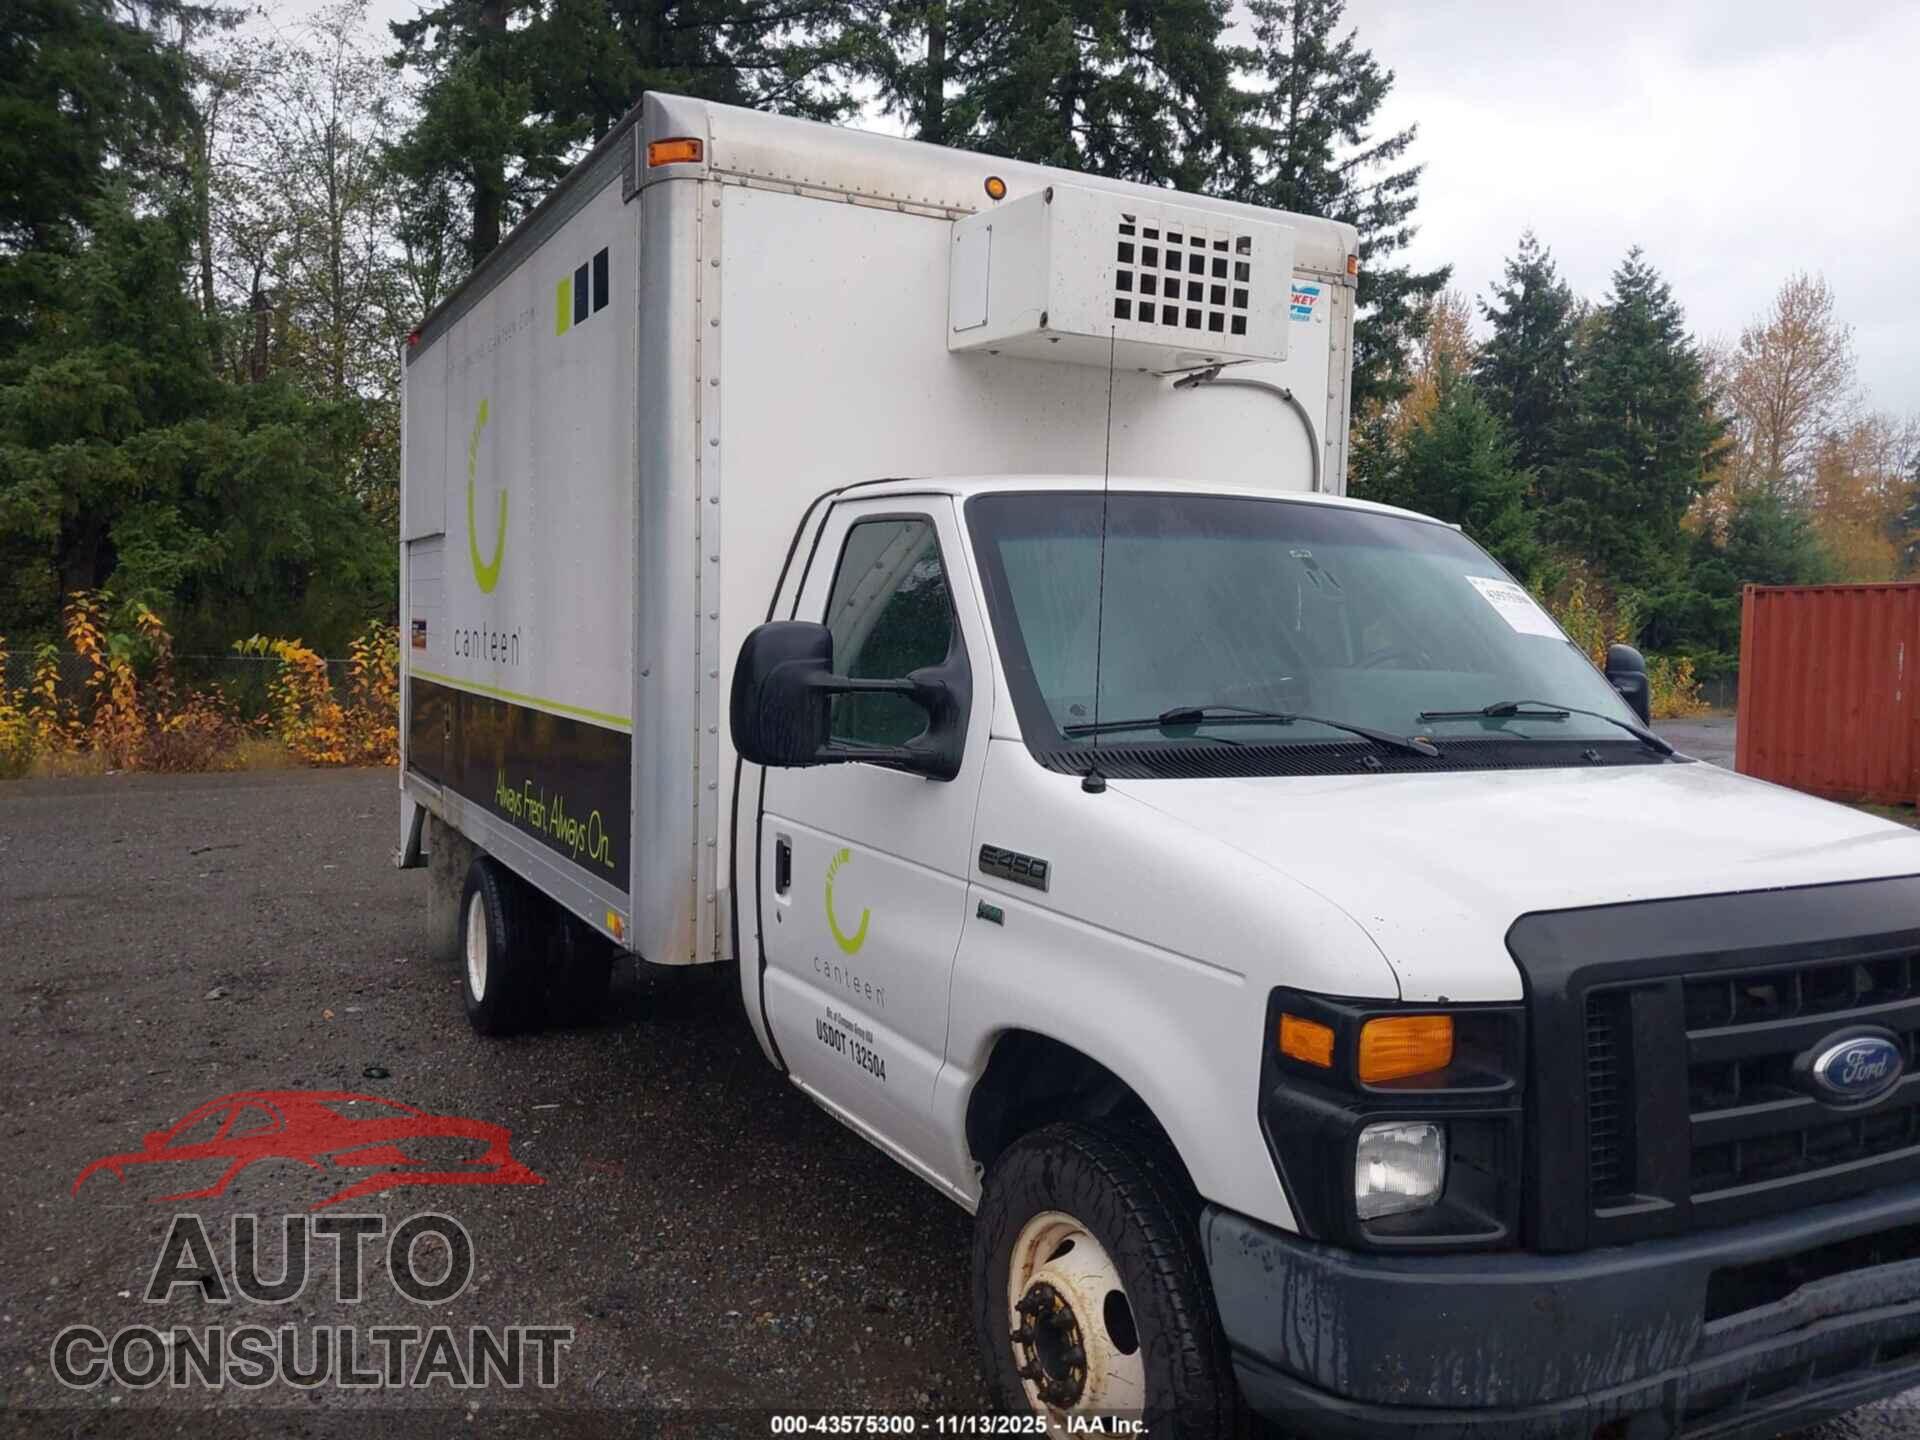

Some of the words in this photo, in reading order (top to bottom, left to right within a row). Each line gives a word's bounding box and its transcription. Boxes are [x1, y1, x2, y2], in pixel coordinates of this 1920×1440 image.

[1290, 293, 1318, 305] KEY
[455, 622, 519, 666] canteen
[495, 768, 522, 823] Always
[549, 793, 586, 859] Always
[813, 956, 886, 1008] canteen
[816, 1017, 846, 1055] USDOT
[849, 1039, 886, 1082] 132504
[1842, 1048, 1888, 1084] Ford
